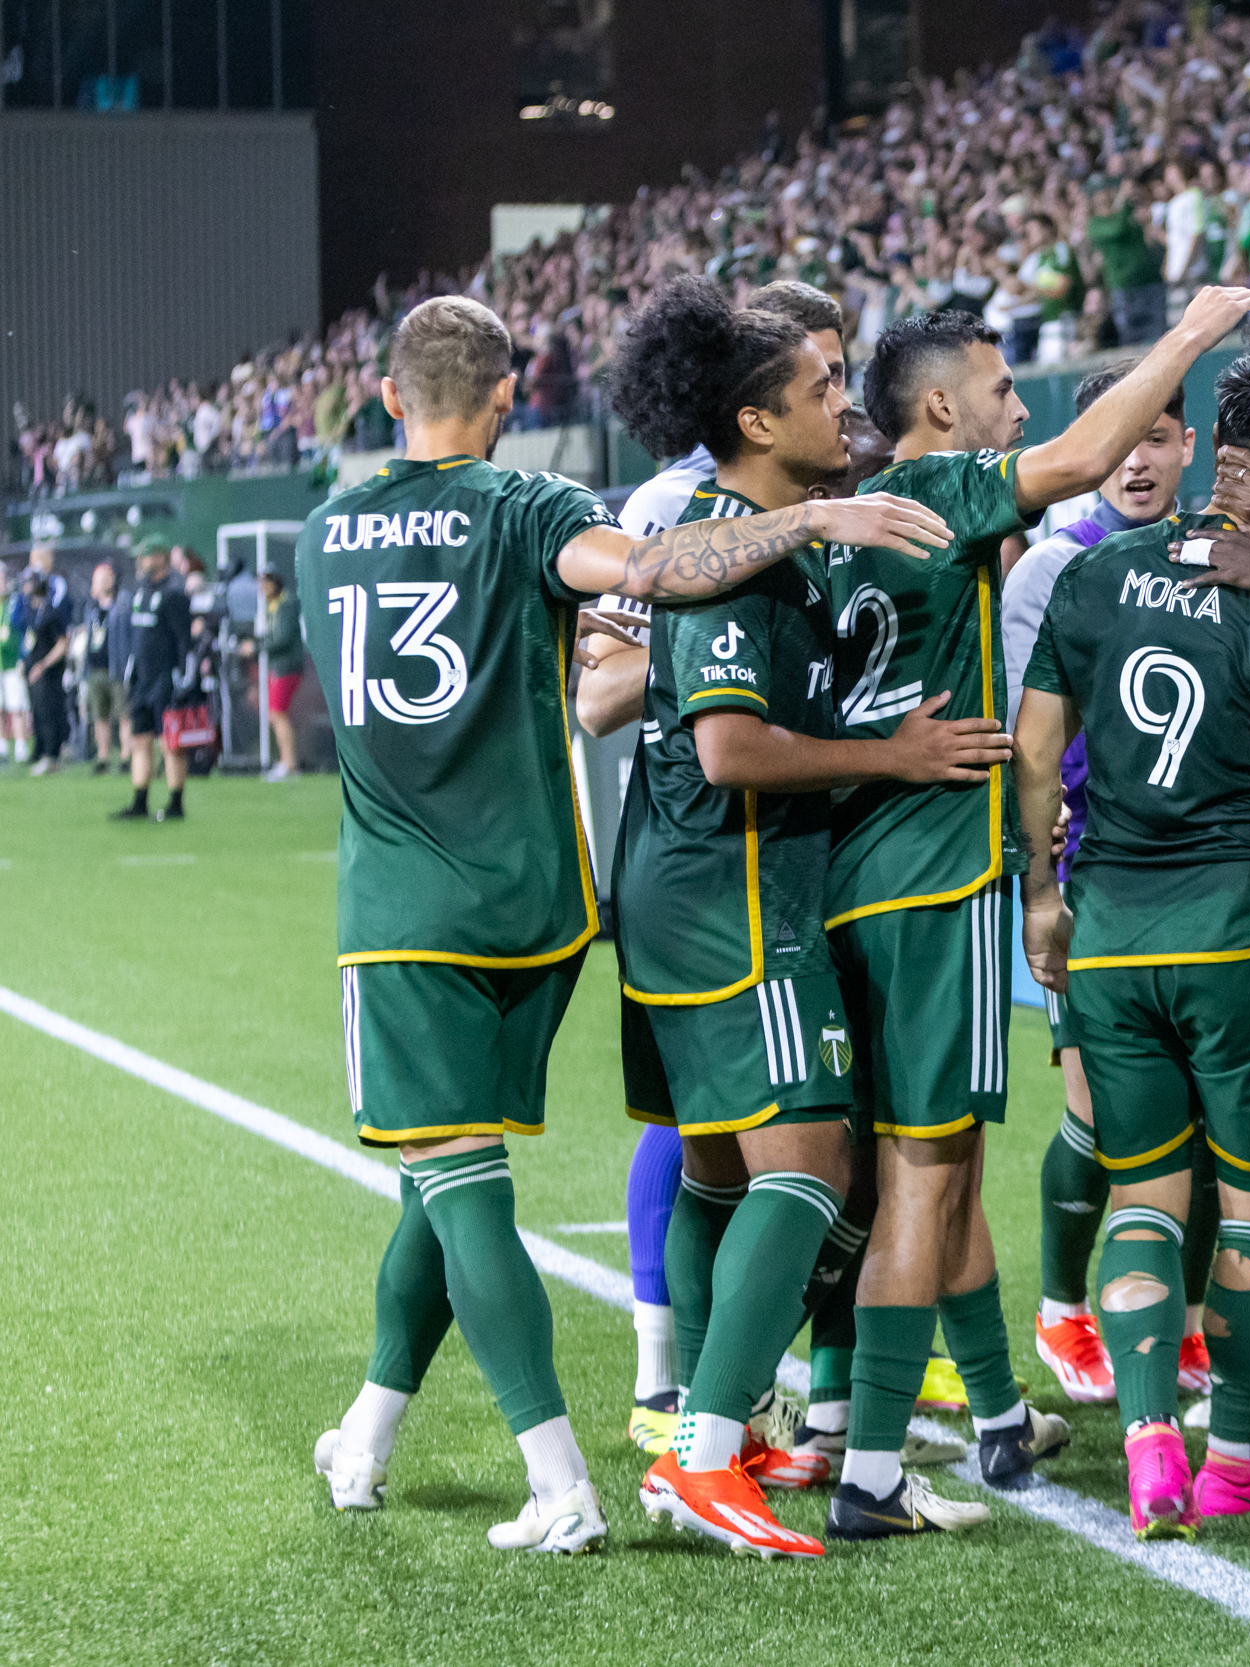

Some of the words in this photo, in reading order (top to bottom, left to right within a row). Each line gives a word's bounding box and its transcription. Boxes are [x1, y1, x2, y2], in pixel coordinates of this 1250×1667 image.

[323, 510, 471, 552] ZUPARIC
[1119, 569, 1222, 625] MORA
[327, 581, 468, 726] 13
[700, 664, 758, 685] TikTok
[1119, 645, 1206, 789] 9
